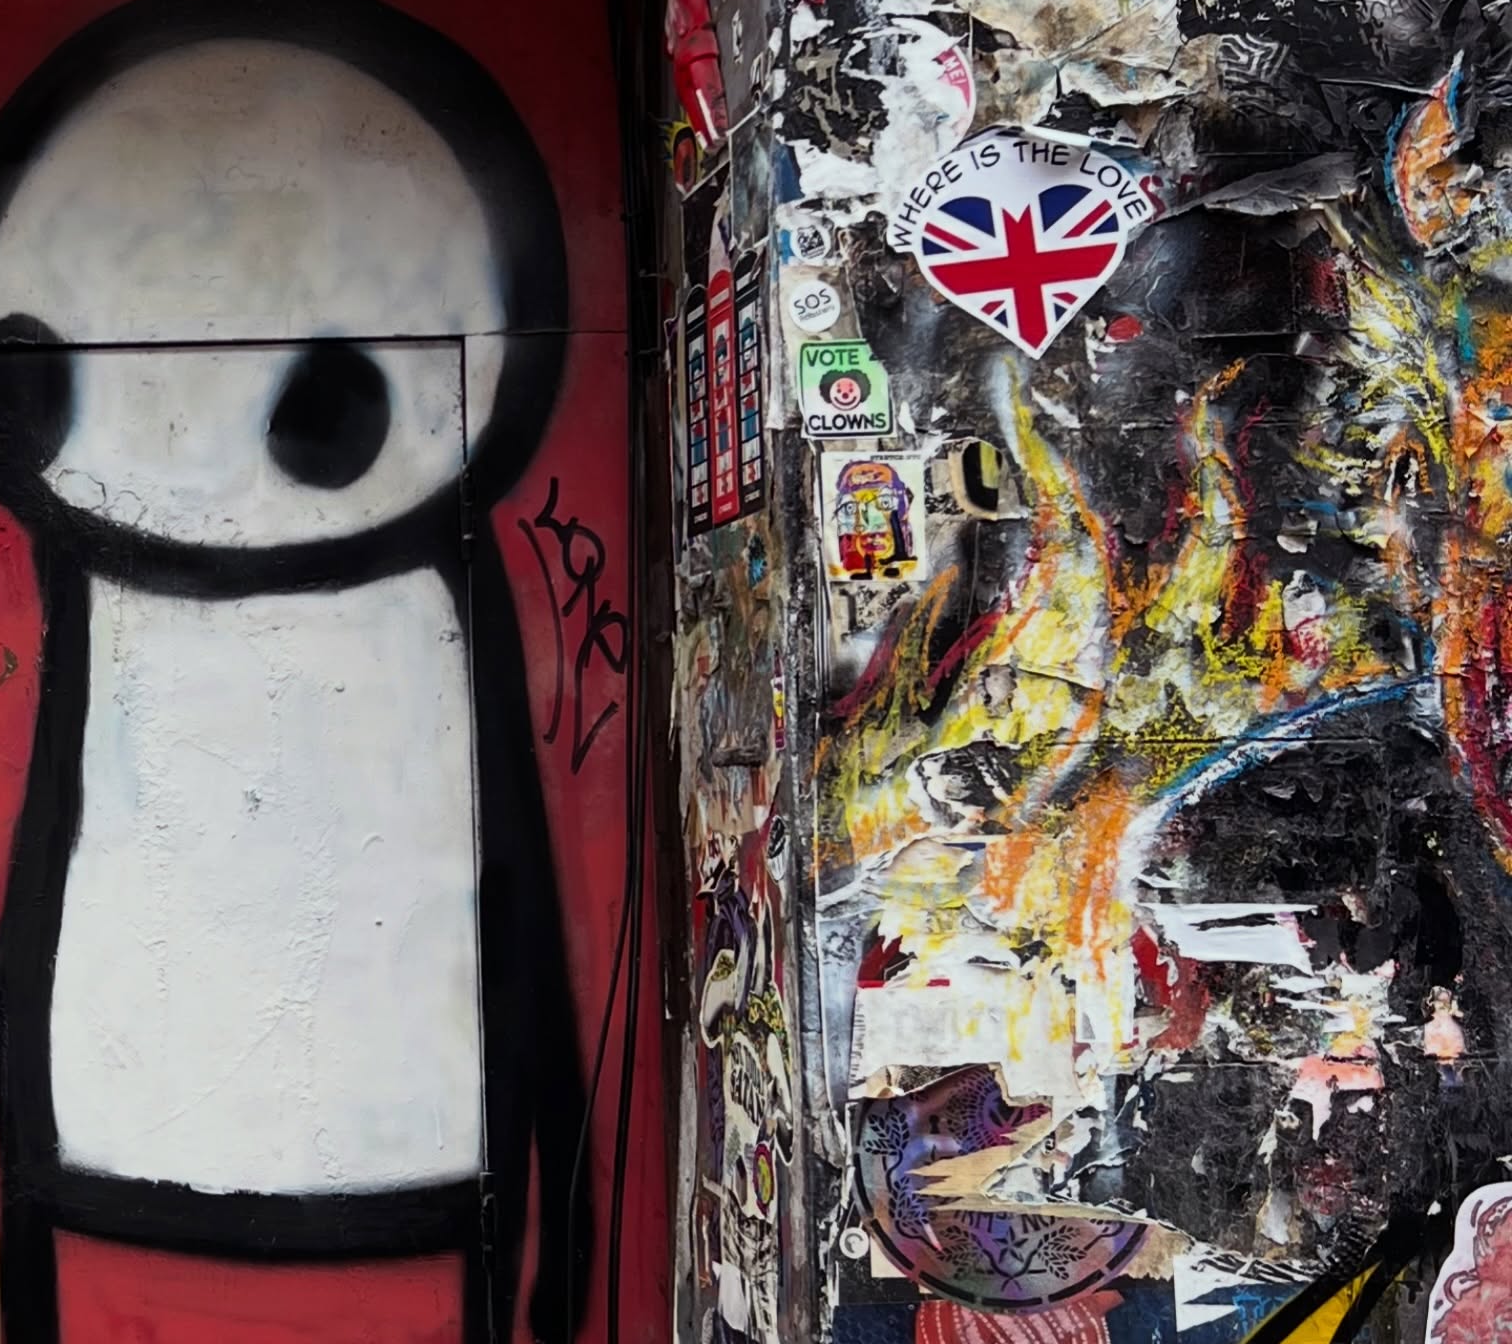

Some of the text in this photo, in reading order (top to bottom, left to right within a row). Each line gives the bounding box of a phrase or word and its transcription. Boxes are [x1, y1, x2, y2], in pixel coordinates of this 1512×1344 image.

[893, 158, 964, 248] WHERE
[970, 143, 1001, 171] IS
[1013, 140, 1072, 167] THE
[1079, 152, 1148, 220] LOVE
[793, 288, 832, 314] SOS
[805, 348, 860, 368] VOTE
[808, 412, 887, 432] CLOWNS
